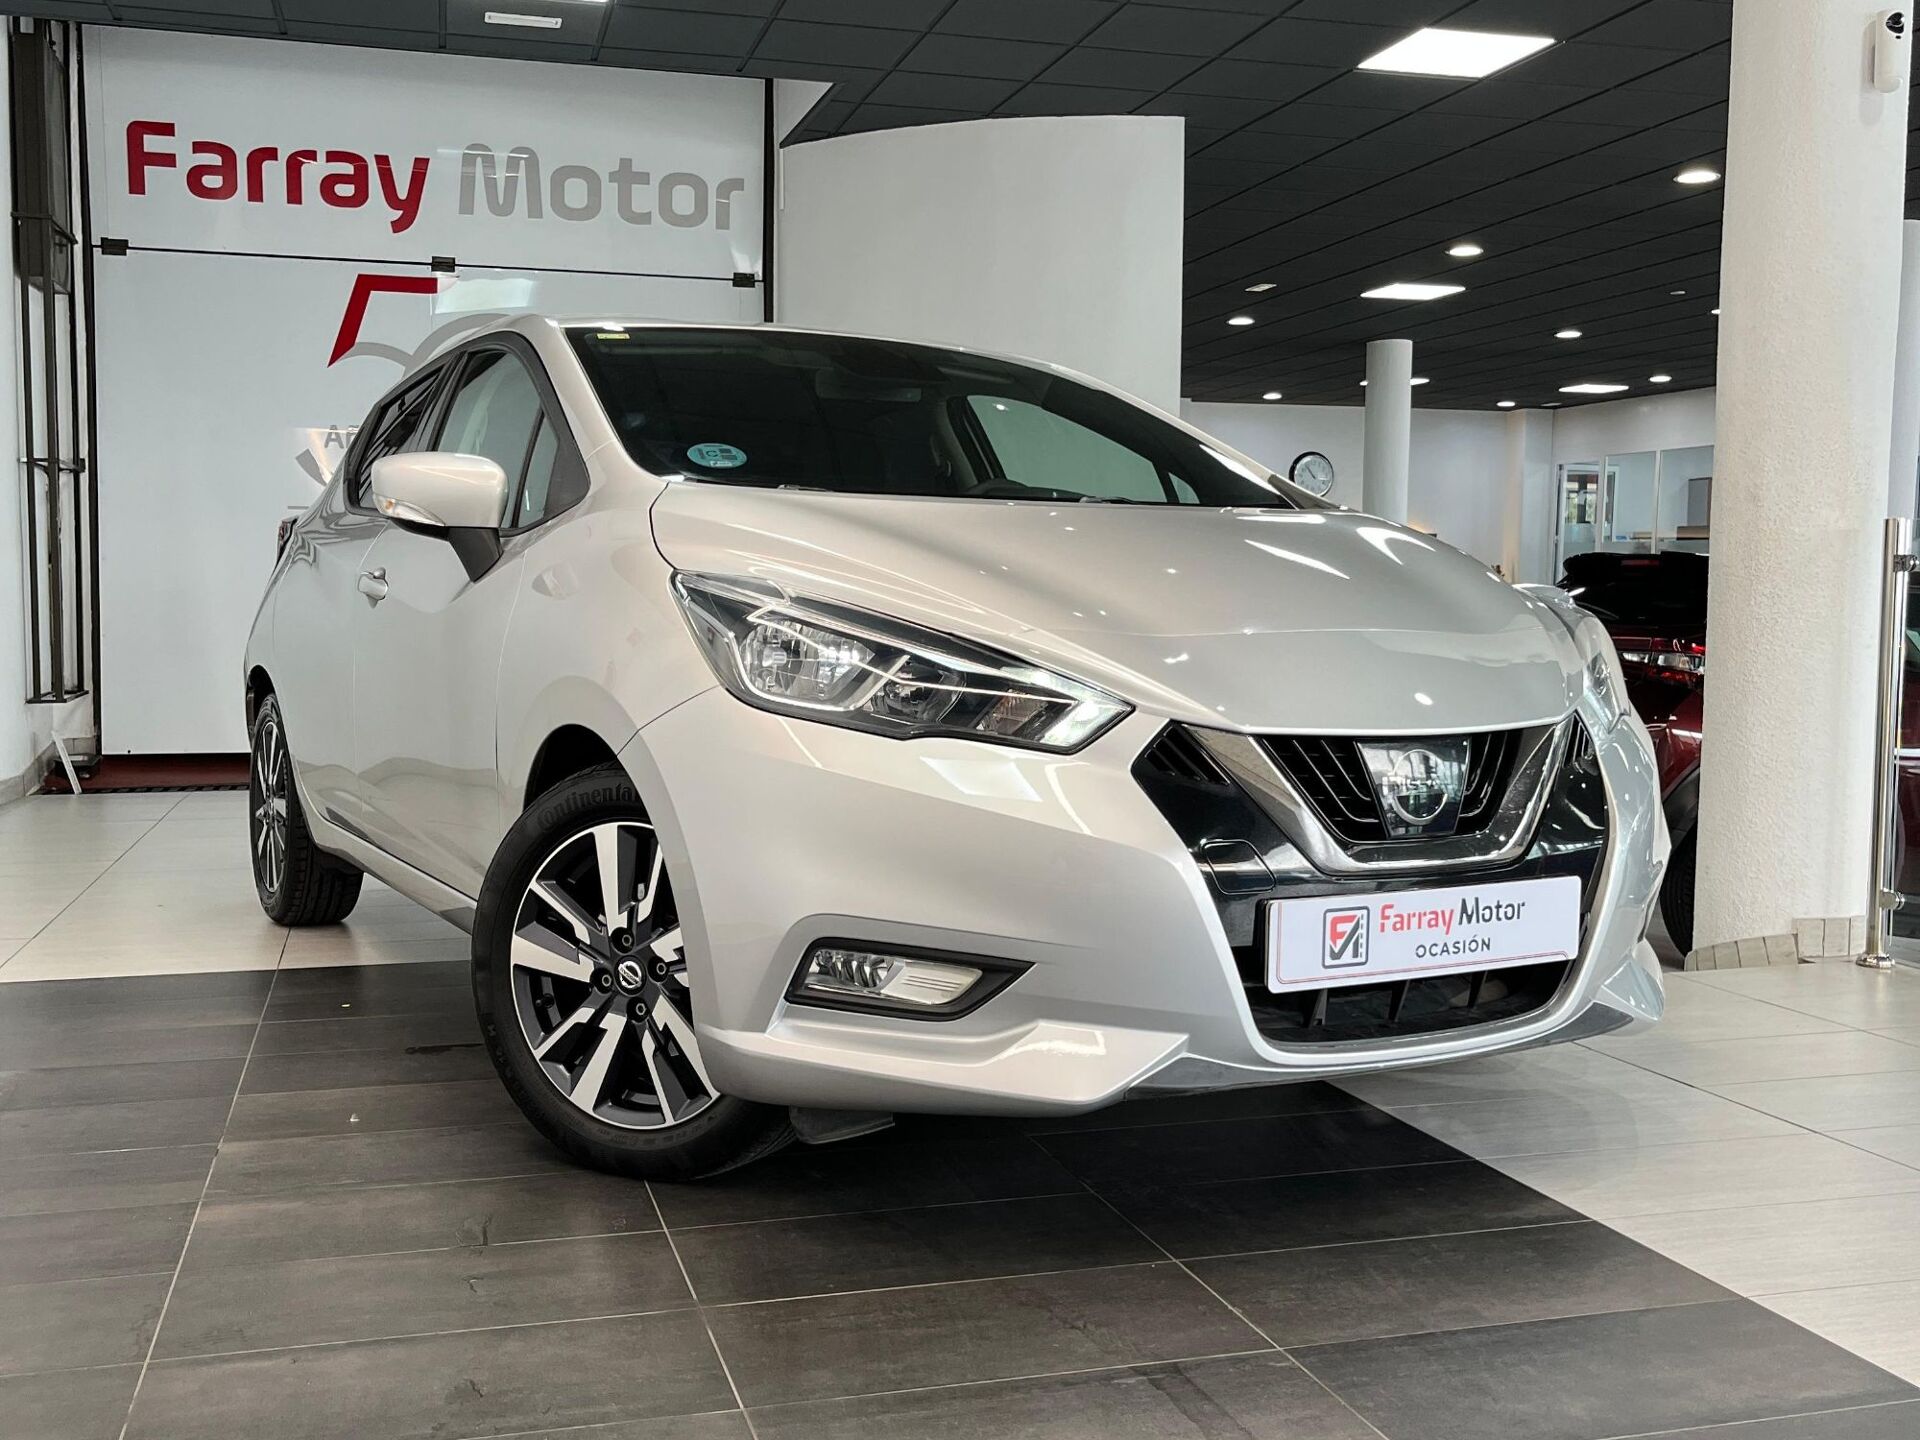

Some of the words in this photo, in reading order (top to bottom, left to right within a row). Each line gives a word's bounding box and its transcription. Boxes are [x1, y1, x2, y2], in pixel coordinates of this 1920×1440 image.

[126, 120, 430, 233] Farray
[458, 143, 745, 230] Motor
[1379, 903, 1454, 935] Farray
[1458, 897, 1526, 926] Motor
[1415, 934, 1491, 959] OCASIÓN
